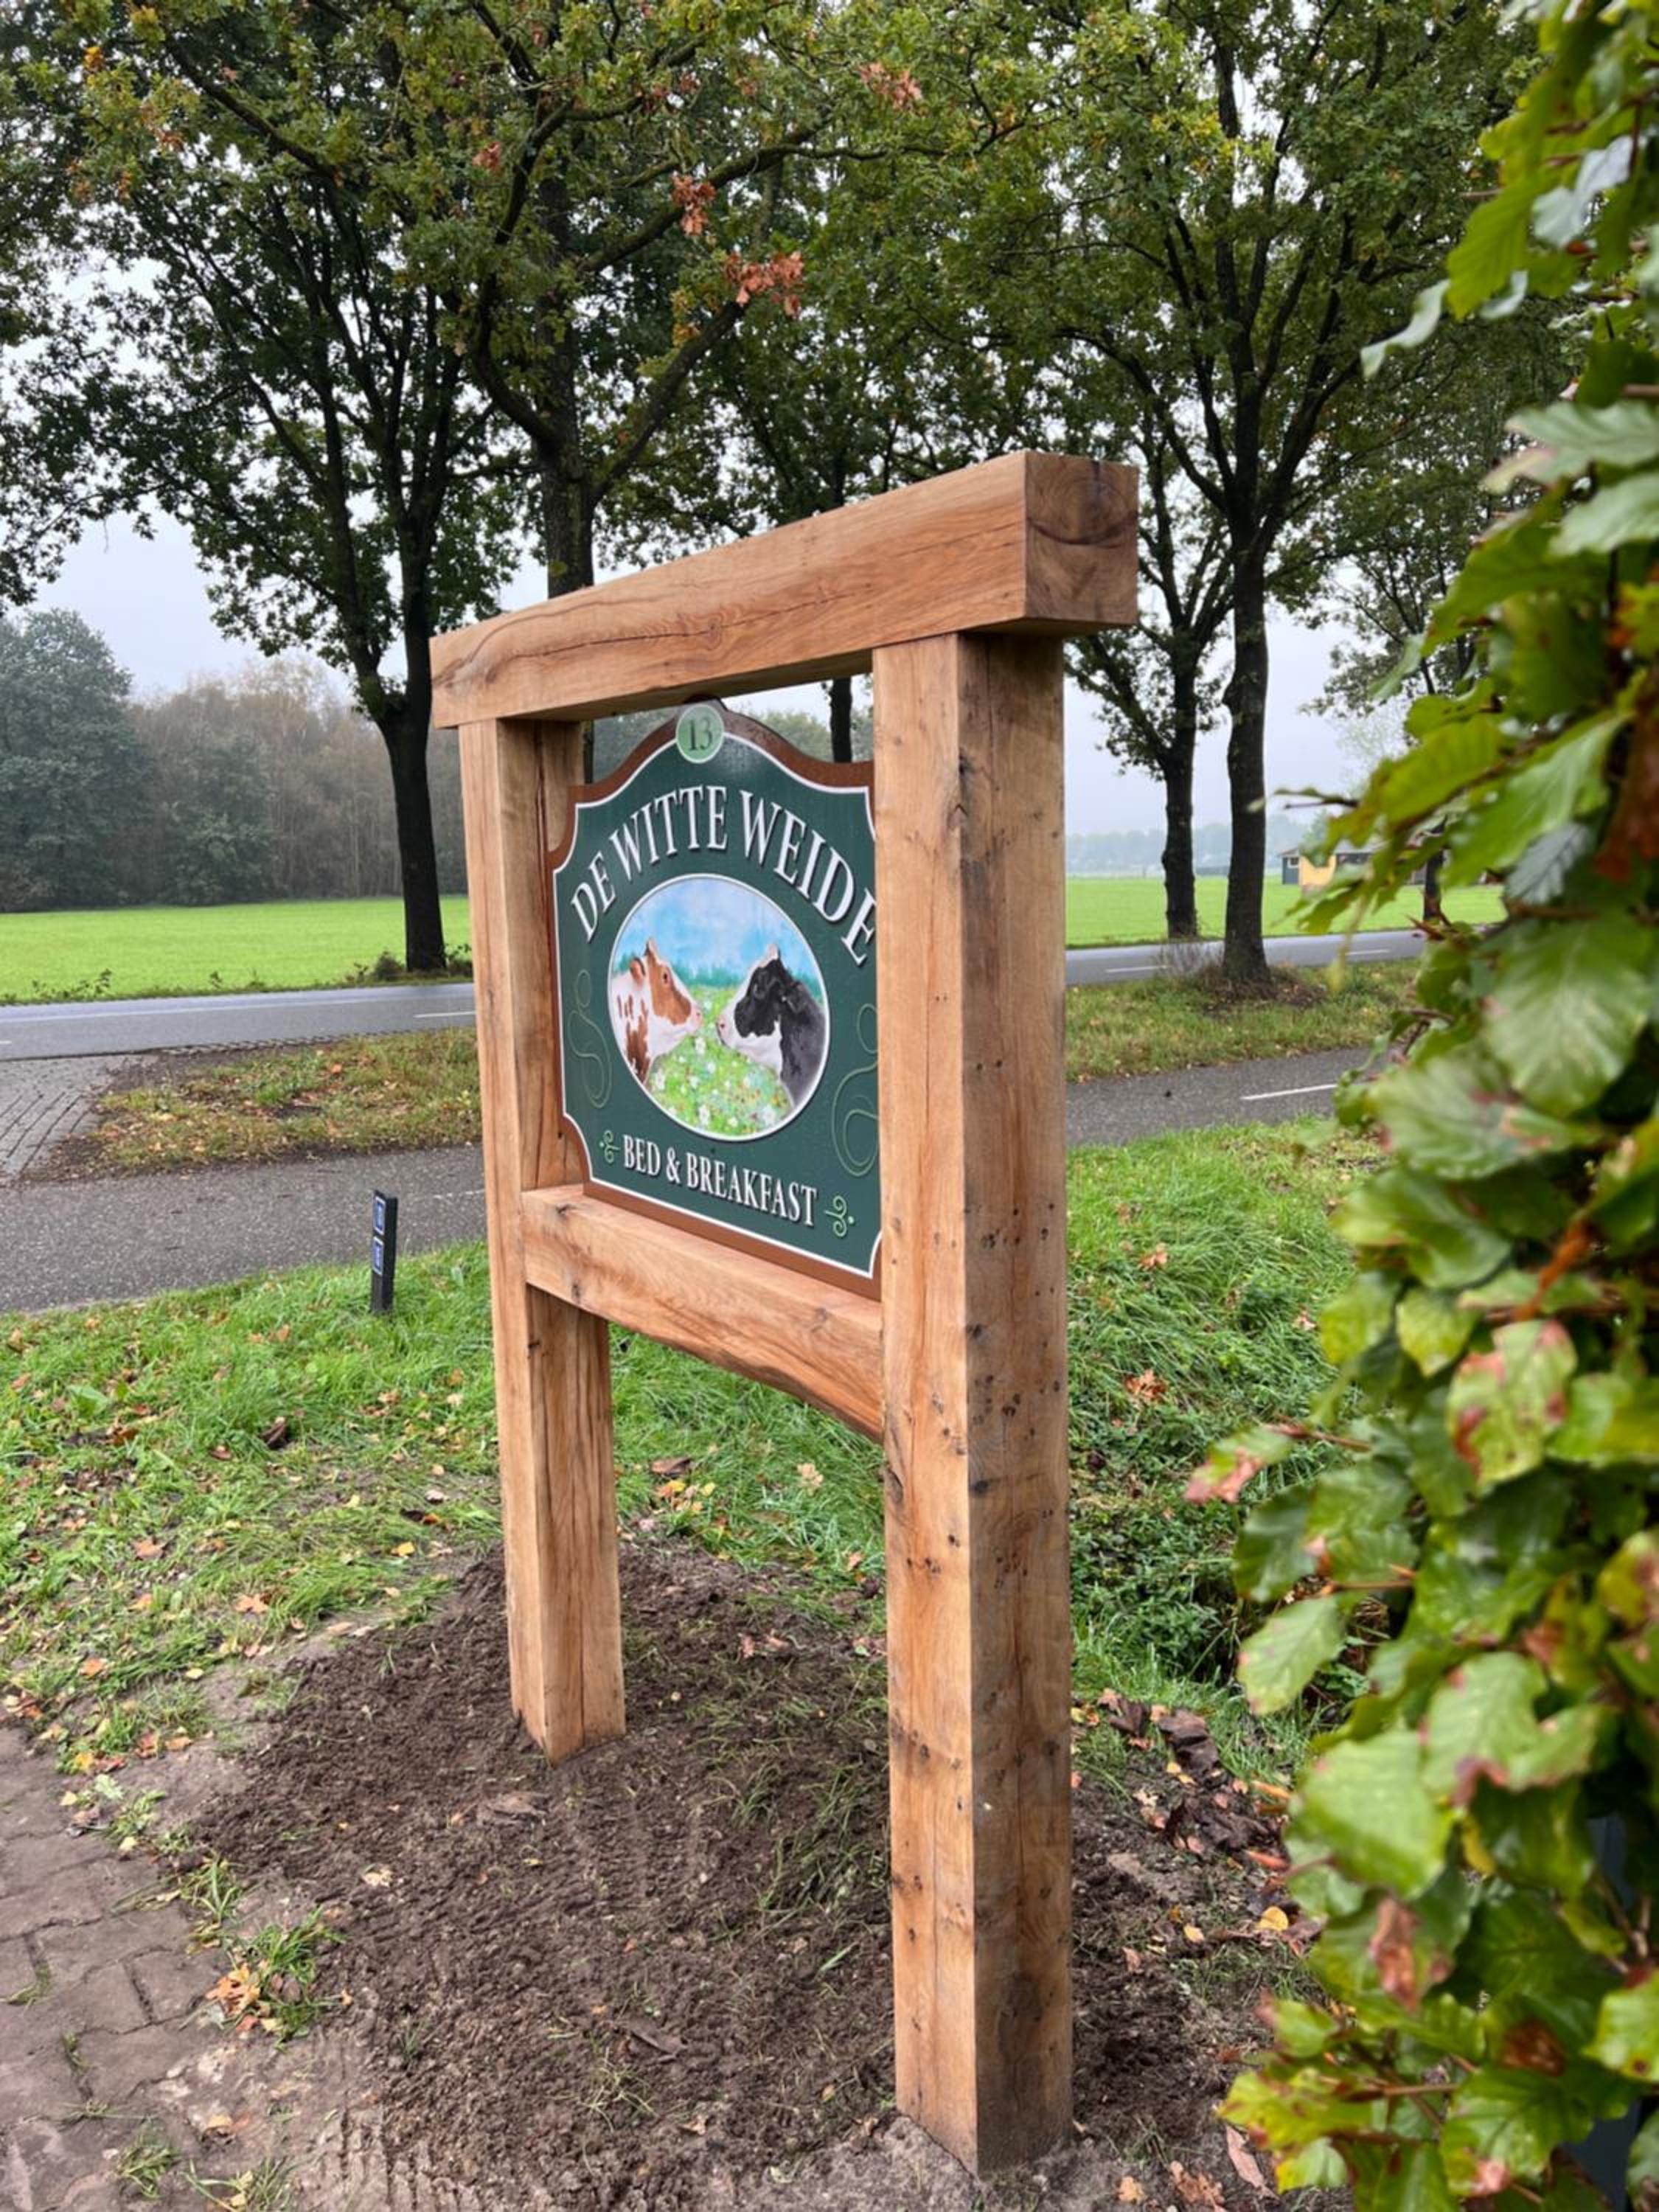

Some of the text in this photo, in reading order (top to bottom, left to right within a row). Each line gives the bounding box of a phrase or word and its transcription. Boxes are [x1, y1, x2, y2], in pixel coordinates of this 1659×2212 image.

[686, 720, 713, 751] 13
[571, 785, 876, 965] DE WITTE WEIDE
[623, 1135, 817, 1226] BED & BREAKFAST
